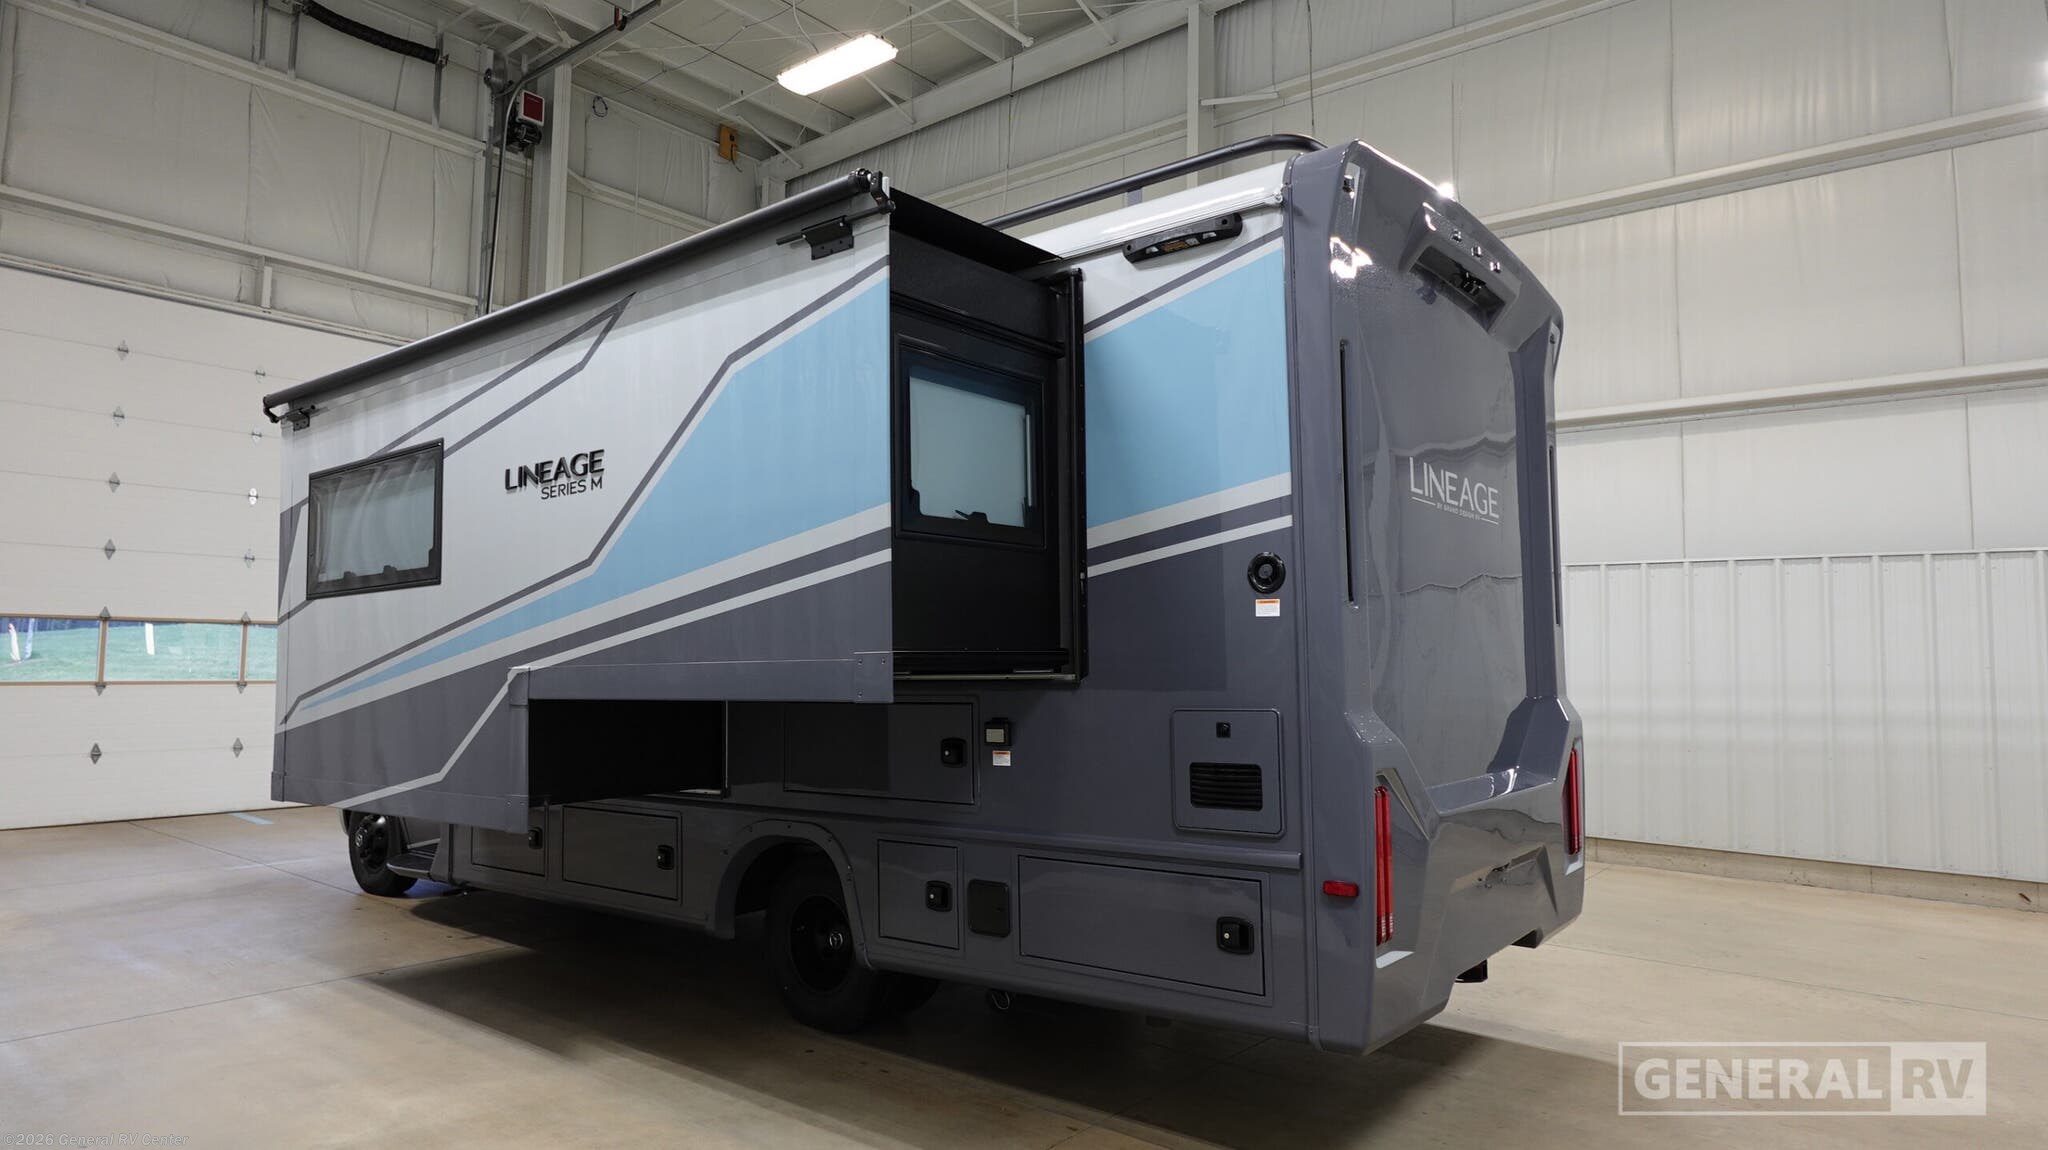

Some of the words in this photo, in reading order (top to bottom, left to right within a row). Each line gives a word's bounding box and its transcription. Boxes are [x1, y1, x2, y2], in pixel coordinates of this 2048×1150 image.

[505, 449, 605, 491] LINEAGE
[541, 479, 587, 500] SERIES
[590, 476, 603, 490] M
[1409, 456, 1500, 518] LINEAGE
